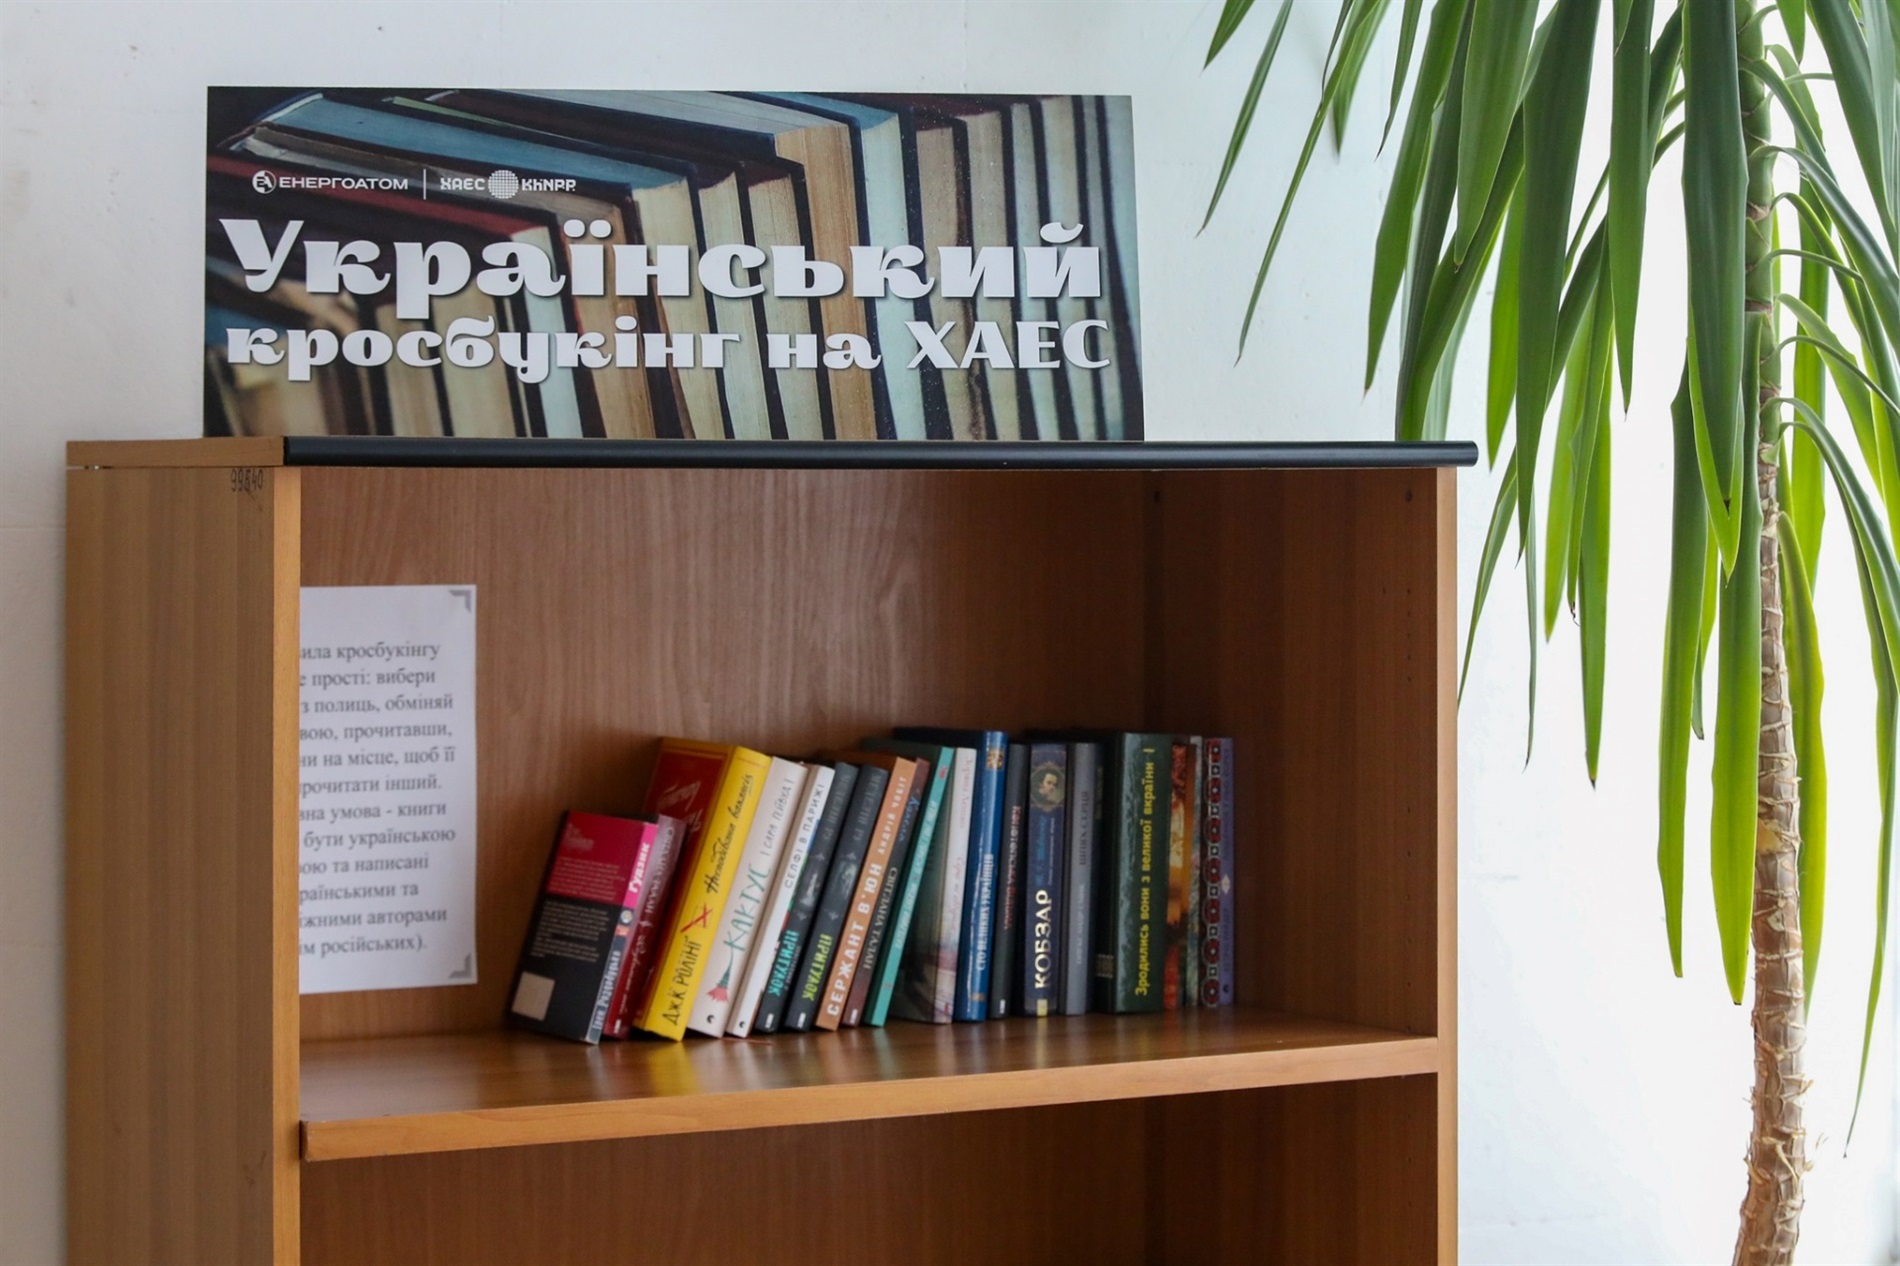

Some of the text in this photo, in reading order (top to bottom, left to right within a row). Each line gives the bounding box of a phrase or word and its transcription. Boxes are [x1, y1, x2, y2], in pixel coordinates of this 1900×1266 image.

[279, 177, 409, 190] ЕНЕРГОАТОМ
[440, 177, 486, 191] ХАЕС
[219, 218, 1101, 319] Український
[226, 314, 1111, 384] кросбукінг на ХАЕС
[336, 641, 441, 663] кросбукінгу
[312, 668, 371, 691] прості:
[376, 667, 436, 688] вибери
[314, 699, 381, 714] полиць,
[385, 693, 454, 712] обміняй
[343, 723, 453, 743] прочитавши,
[323, 753, 342, 767] на
[348, 748, 399, 766] місце,
[404, 745, 440, 765] щоб
[444, 746, 456, 762] її
[299, 774, 442, 799] рочитати інший.
[1142, 762, 1156, 815] вкраїни
[330, 806, 381, 824] умова
[397, 803, 447, 818] книги
[303, 828, 456, 852] бути українською
[784, 849, 804, 889] СЕЛФІ
[802, 783, 826, 833] ПАРИЖІ
[1140, 819, 1152, 872] великої
[332, 861, 350, 873] та
[354, 852, 429, 873] написані
[402, 884, 419, 897] та
[1141, 875, 1150, 884] з
[723, 862, 772, 952] КАКТУС
[826, 921, 865, 1017] СЕРЖАНТ
[877, 812, 897, 856] АНДРІЙ
[891, 776, 908, 809] ЧОБІТ
[1140, 887, 1150, 920] вони
[366, 909, 448, 928] авторами
[863, 866, 898, 970] СВІТЛАНА ТАЛАН
[320, 935, 428, 959] російських).
[1034, 889, 1052, 989] КОБЗАР
[767, 929, 800, 997] ПРИТУЛОК
[801, 933, 834, 1002] ПРИТУЛОК
[1135, 924, 1150, 996] Зродились
